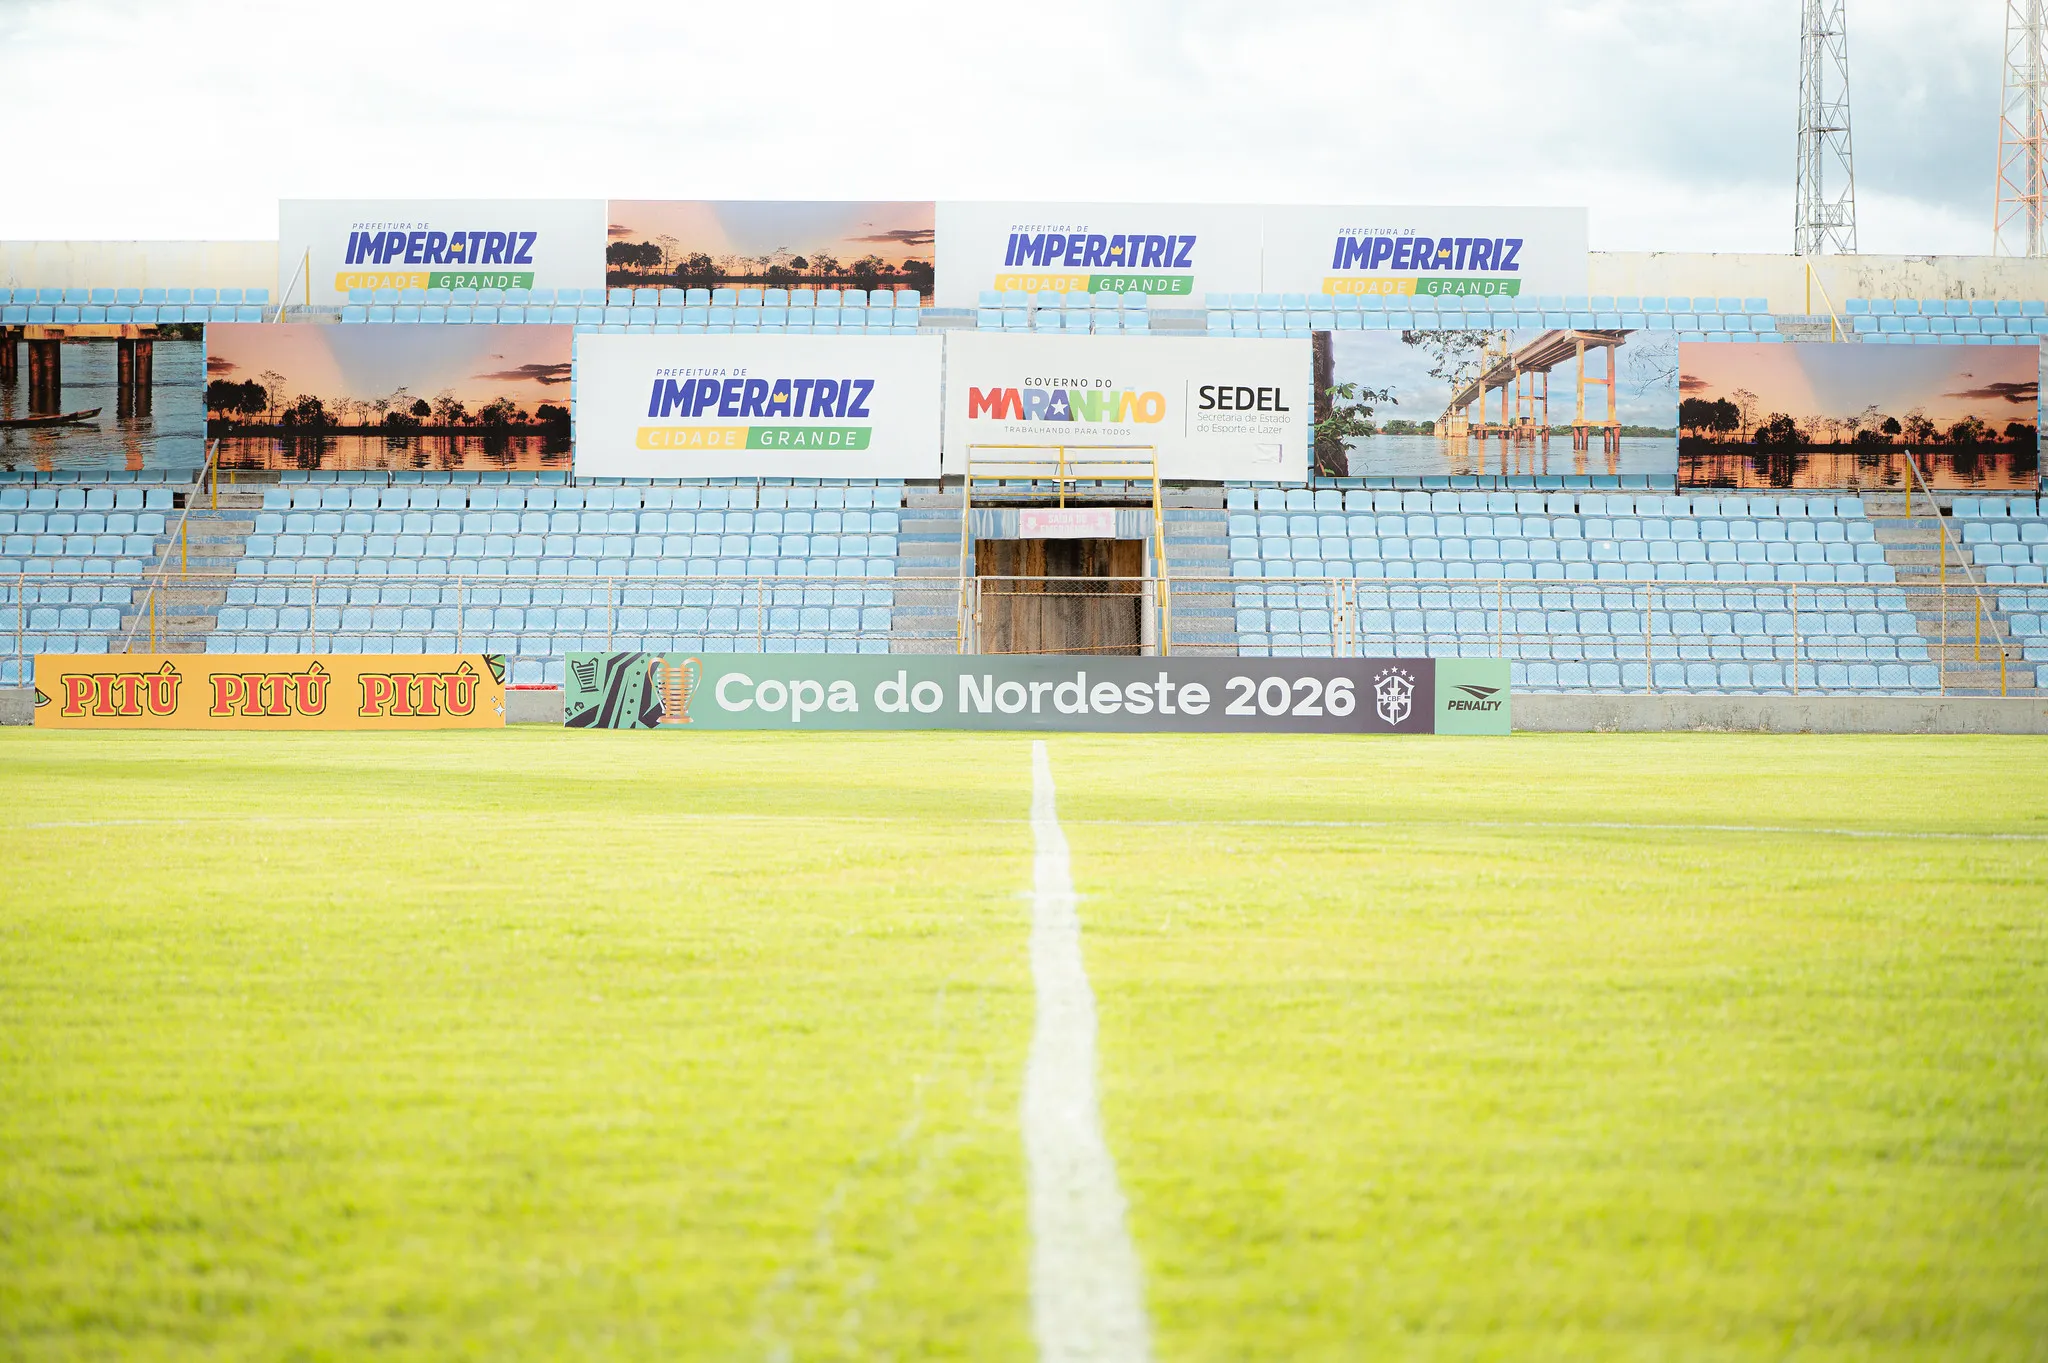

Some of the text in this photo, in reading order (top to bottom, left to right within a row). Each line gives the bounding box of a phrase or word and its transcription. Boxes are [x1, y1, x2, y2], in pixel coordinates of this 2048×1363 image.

[352, 222, 430, 230] PREFEITURA DE
[1011, 224, 1089, 233] PREFEITURA DE
[1338, 228, 1416, 236] PREFEITURA DE
[344, 231, 538, 265] IMPERATRIZ
[1004, 233, 1197, 268] IMPERATRIZ
[1332, 236, 1524, 271] IMPERATRIZ
[345, 275, 522, 289] CIDADE GRANDE
[1004, 277, 1182, 292] CIDADE GRANDE
[1332, 280, 1509, 295] CIDADE GRANDE
[656, 368, 748, 377] PREFEITURA DE
[1024, 377, 1113, 388] GOVERNO DO
[647, 378, 875, 418] IMPERATRIZ
[968, 386, 1166, 424] MARANHÃO
[1198, 385, 1290, 412] SEDEL
[1197, 412, 1291, 424] Secretaria de Estado
[1004, 426, 1131, 436] TRABALHANDO PARA TODOS
[1196, 423, 1210, 433] do
[1211, 424, 1247, 435] Esporte
[1257, 424, 1282, 434] Lazer
[648, 430, 857, 446] CIDADE GRANDE
[60, 660, 182, 717] PITÚ
[209, 660, 331, 717] PITÚ
[358, 660, 480, 717] PITÚ
[714, 670, 1356, 722] Copa do Nordeste 2026
[1447, 700, 1502, 711] PENALTY
